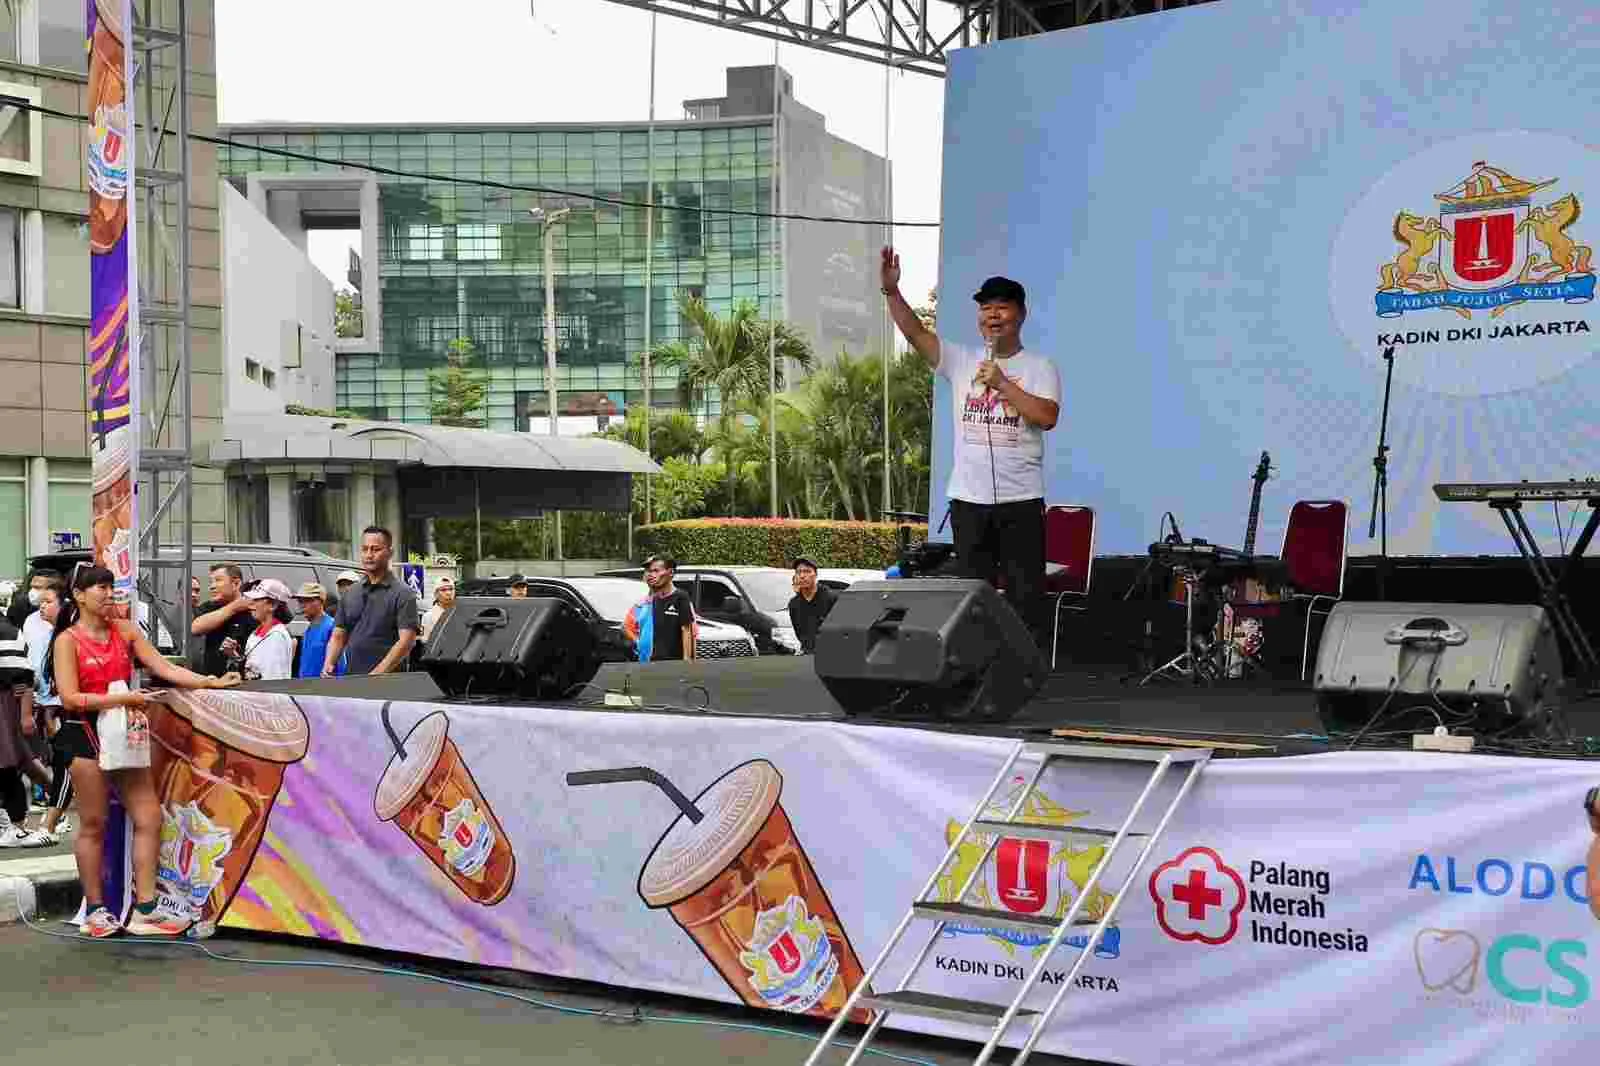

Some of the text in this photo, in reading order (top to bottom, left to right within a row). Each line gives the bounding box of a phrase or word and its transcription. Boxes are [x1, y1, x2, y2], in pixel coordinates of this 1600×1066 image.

[1521, 284, 1575, 297] SETIA
[1377, 320, 1590, 346] KADIN DKI JAKARTA
[1249, 860, 1330, 895] Palang
[1250, 890, 1325, 918] Merah
[1251, 919, 1369, 953] Indonesia
[936, 955, 988, 976] KADIN
[994, 964, 1025, 981] DKI
[1486, 933, 1591, 1009] CS
